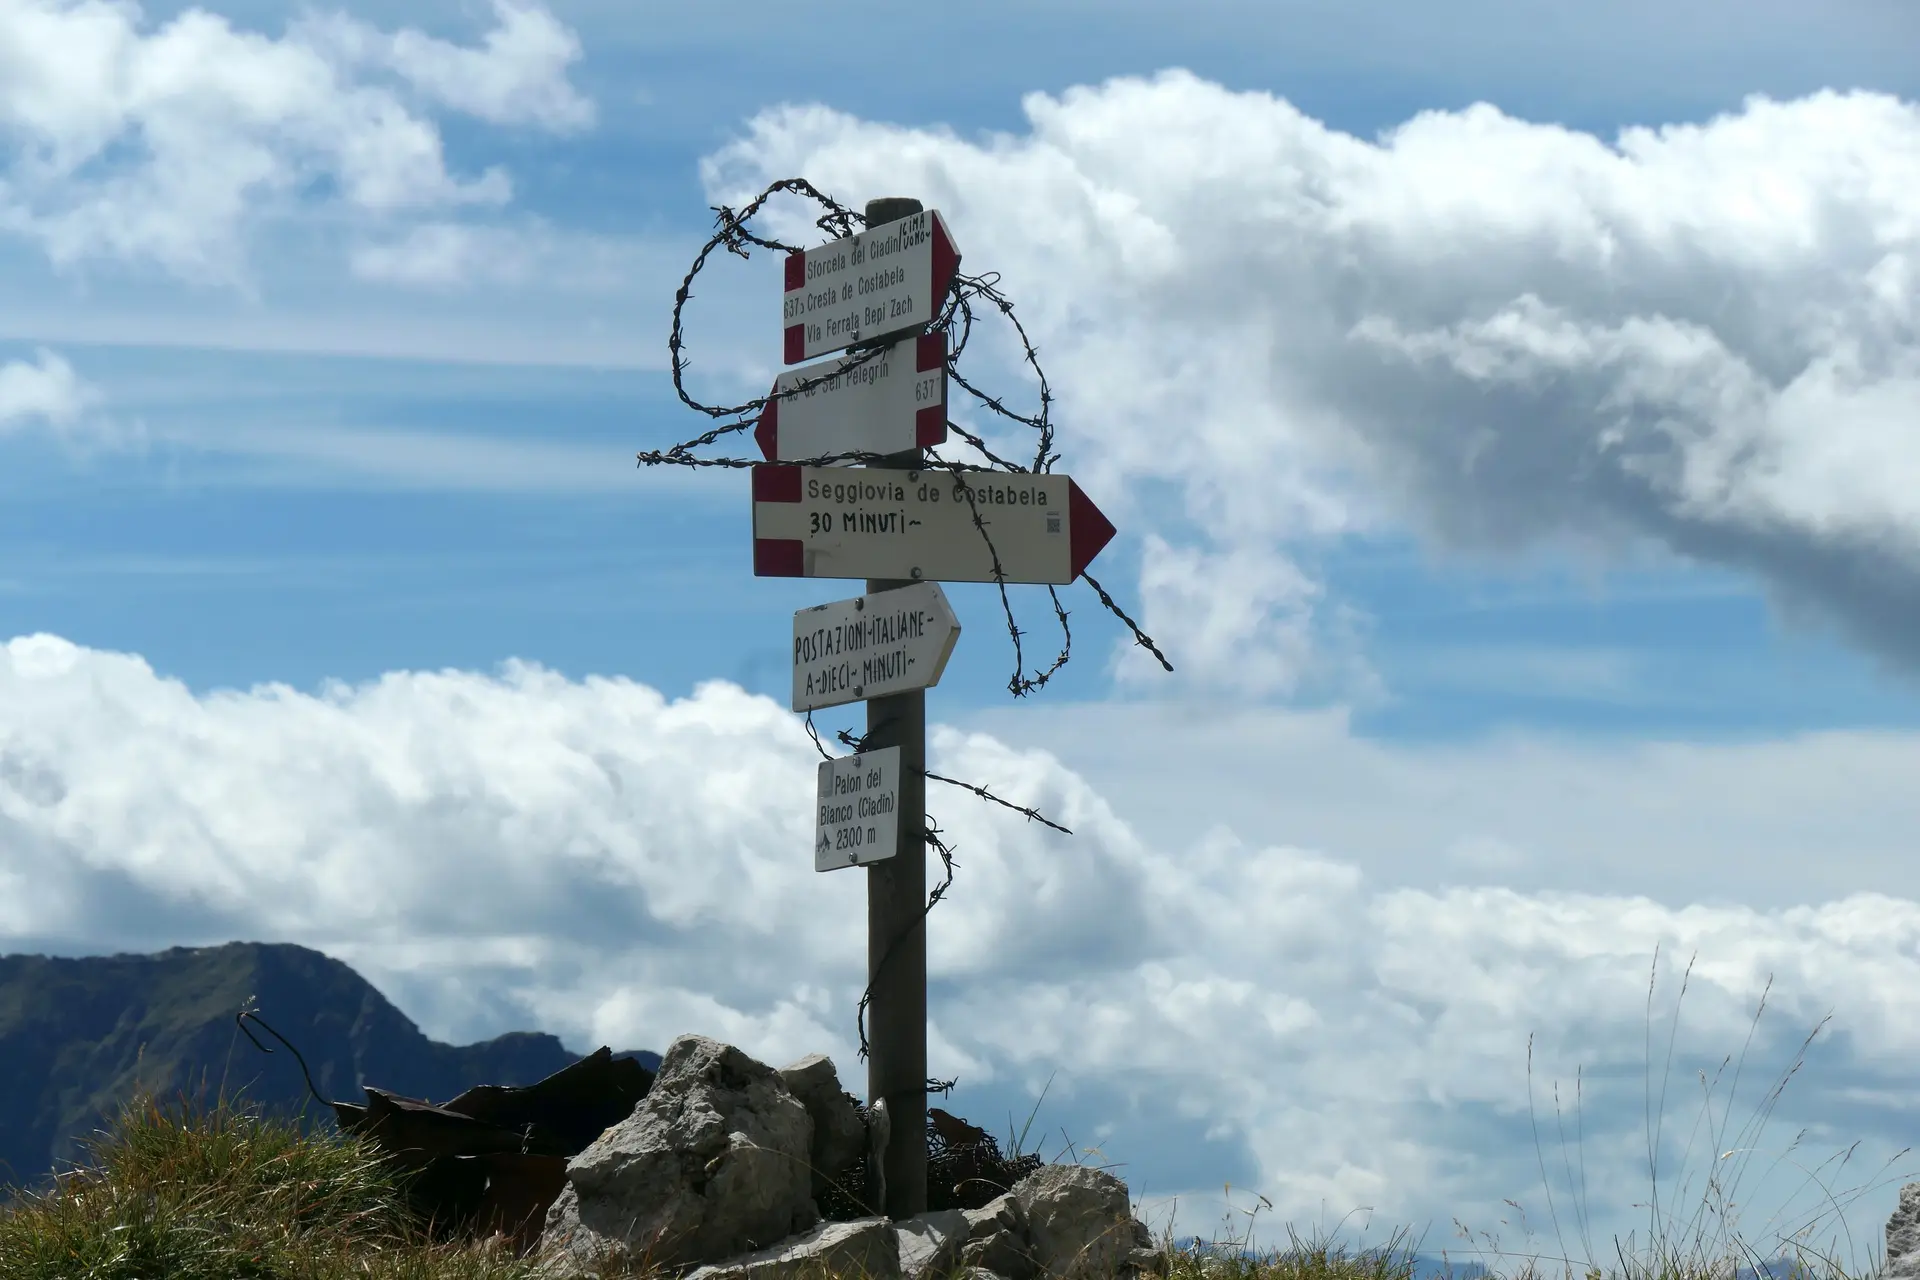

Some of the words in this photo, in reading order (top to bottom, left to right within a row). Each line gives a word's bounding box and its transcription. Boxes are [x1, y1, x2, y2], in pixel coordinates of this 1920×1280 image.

[903, 213, 925, 235] CIMA
[807, 253, 846, 280] Sforcela
[851, 247, 865, 266] del
[807, 287, 836, 312] Cresta
[842, 281, 853, 301] de
[858, 266, 904, 295] Costabela
[807, 322, 821, 343] Via
[826, 311, 860, 333] Ferrata
[864, 301, 885, 326] Bepi
[890, 295, 913, 318] Zach
[846, 361, 889, 387] Pelegrin
[915, 379, 935, 401] 637
[808, 479, 905, 504] Seggiovia
[917, 482, 940, 501] de
[952, 484, 1048, 506] Costabela
[810, 511, 832, 534] 30
[834, 773, 861, 796] Palon
[866, 767, 882, 789] del
[820, 804, 853, 827] Bianco
[858, 790, 894, 819] (Ciadin)
[836, 826, 862, 851] 2300
[867, 827, 876, 845] m
